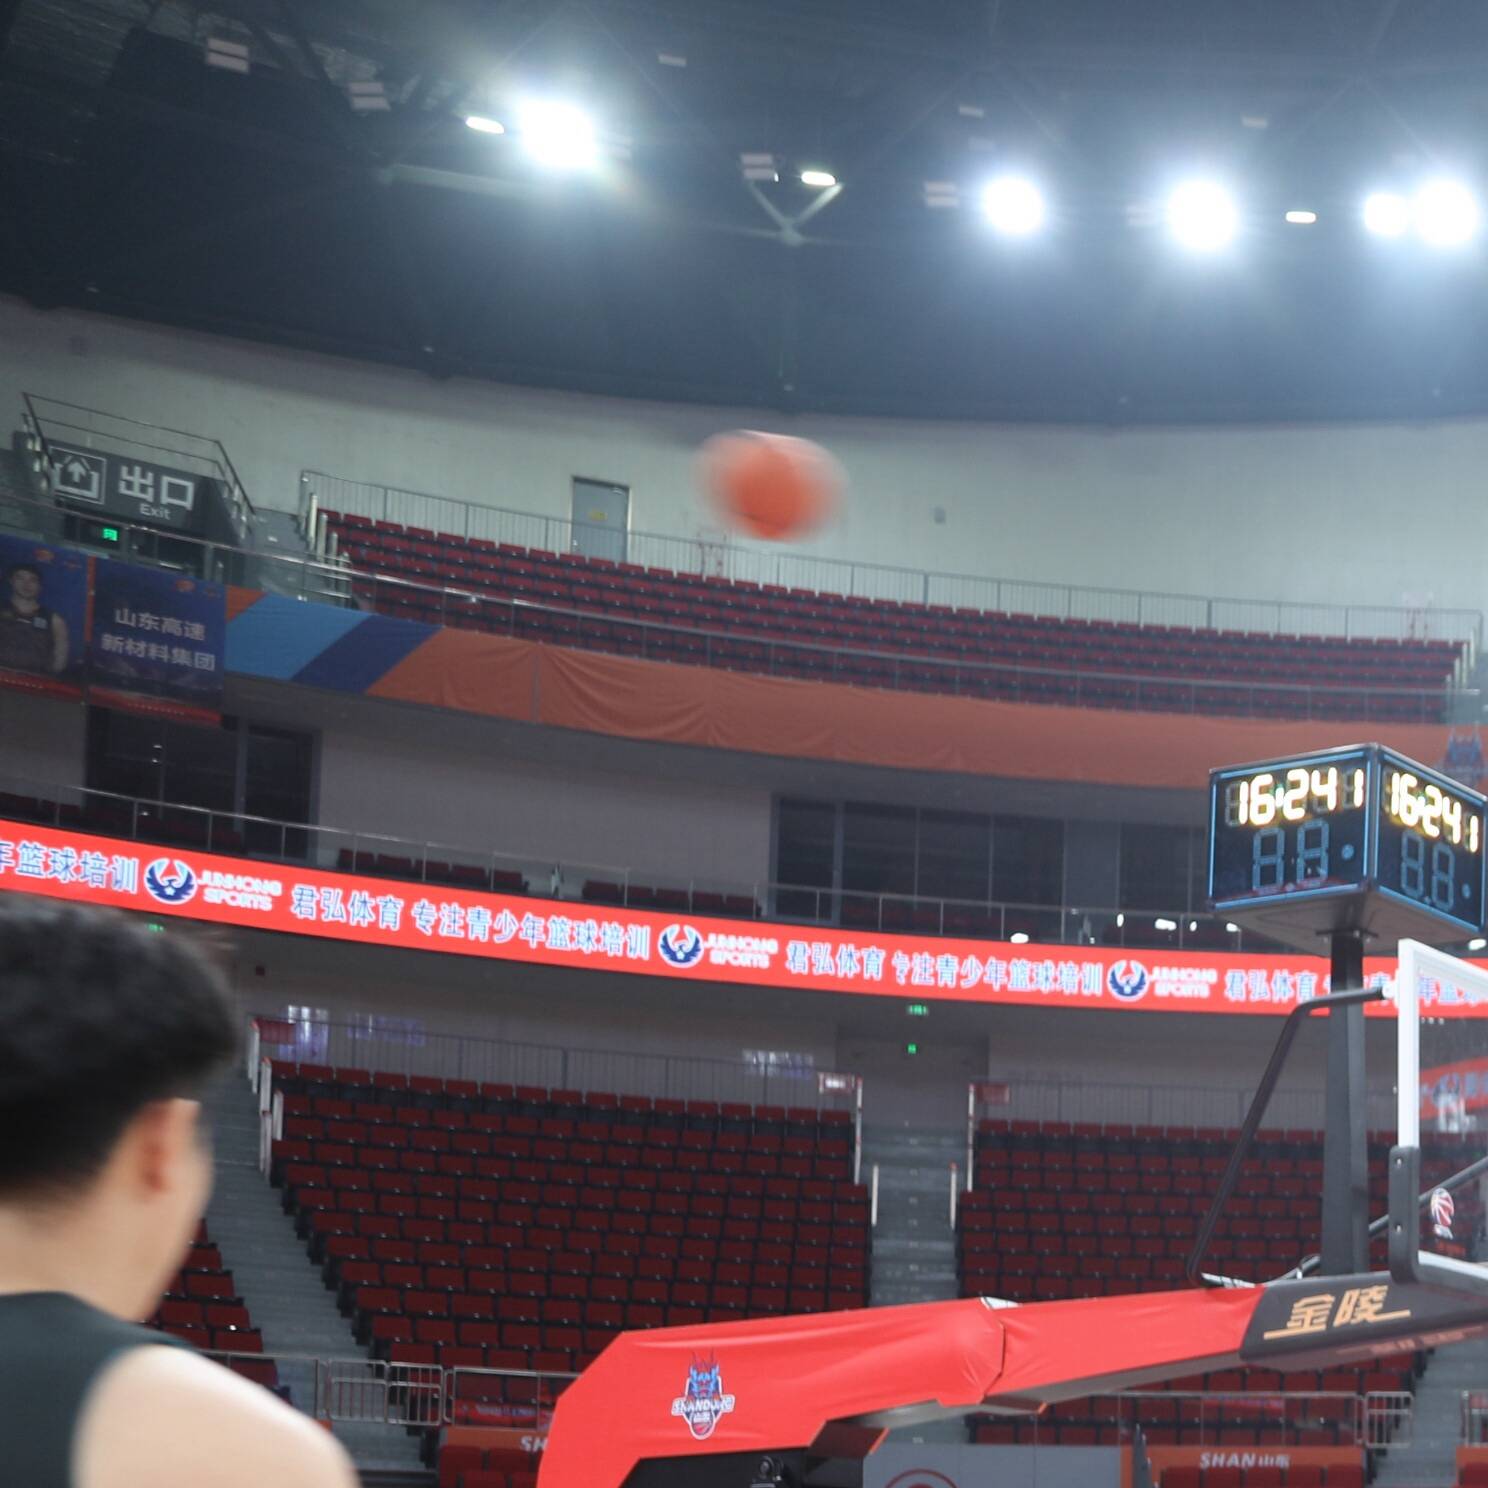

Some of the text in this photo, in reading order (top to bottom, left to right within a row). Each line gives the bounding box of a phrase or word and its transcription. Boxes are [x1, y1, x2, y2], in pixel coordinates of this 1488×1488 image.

[118, 464, 195, 510] 出口
[139, 503, 171, 520] Exit
[115, 608, 206, 642] 山东高速
[102, 633, 216, 672] 新材料集团
[203, 888, 274, 911] SPORTS
[291, 884, 651, 960] 君弘体育 专注青少年篮球培训
[785, 940, 1104, 997] 君弘体育 专注青少年篮球培训
[1264, 1285, 1411, 1340] 金陵
[1200, 1452, 1257, 1470] SHAN
